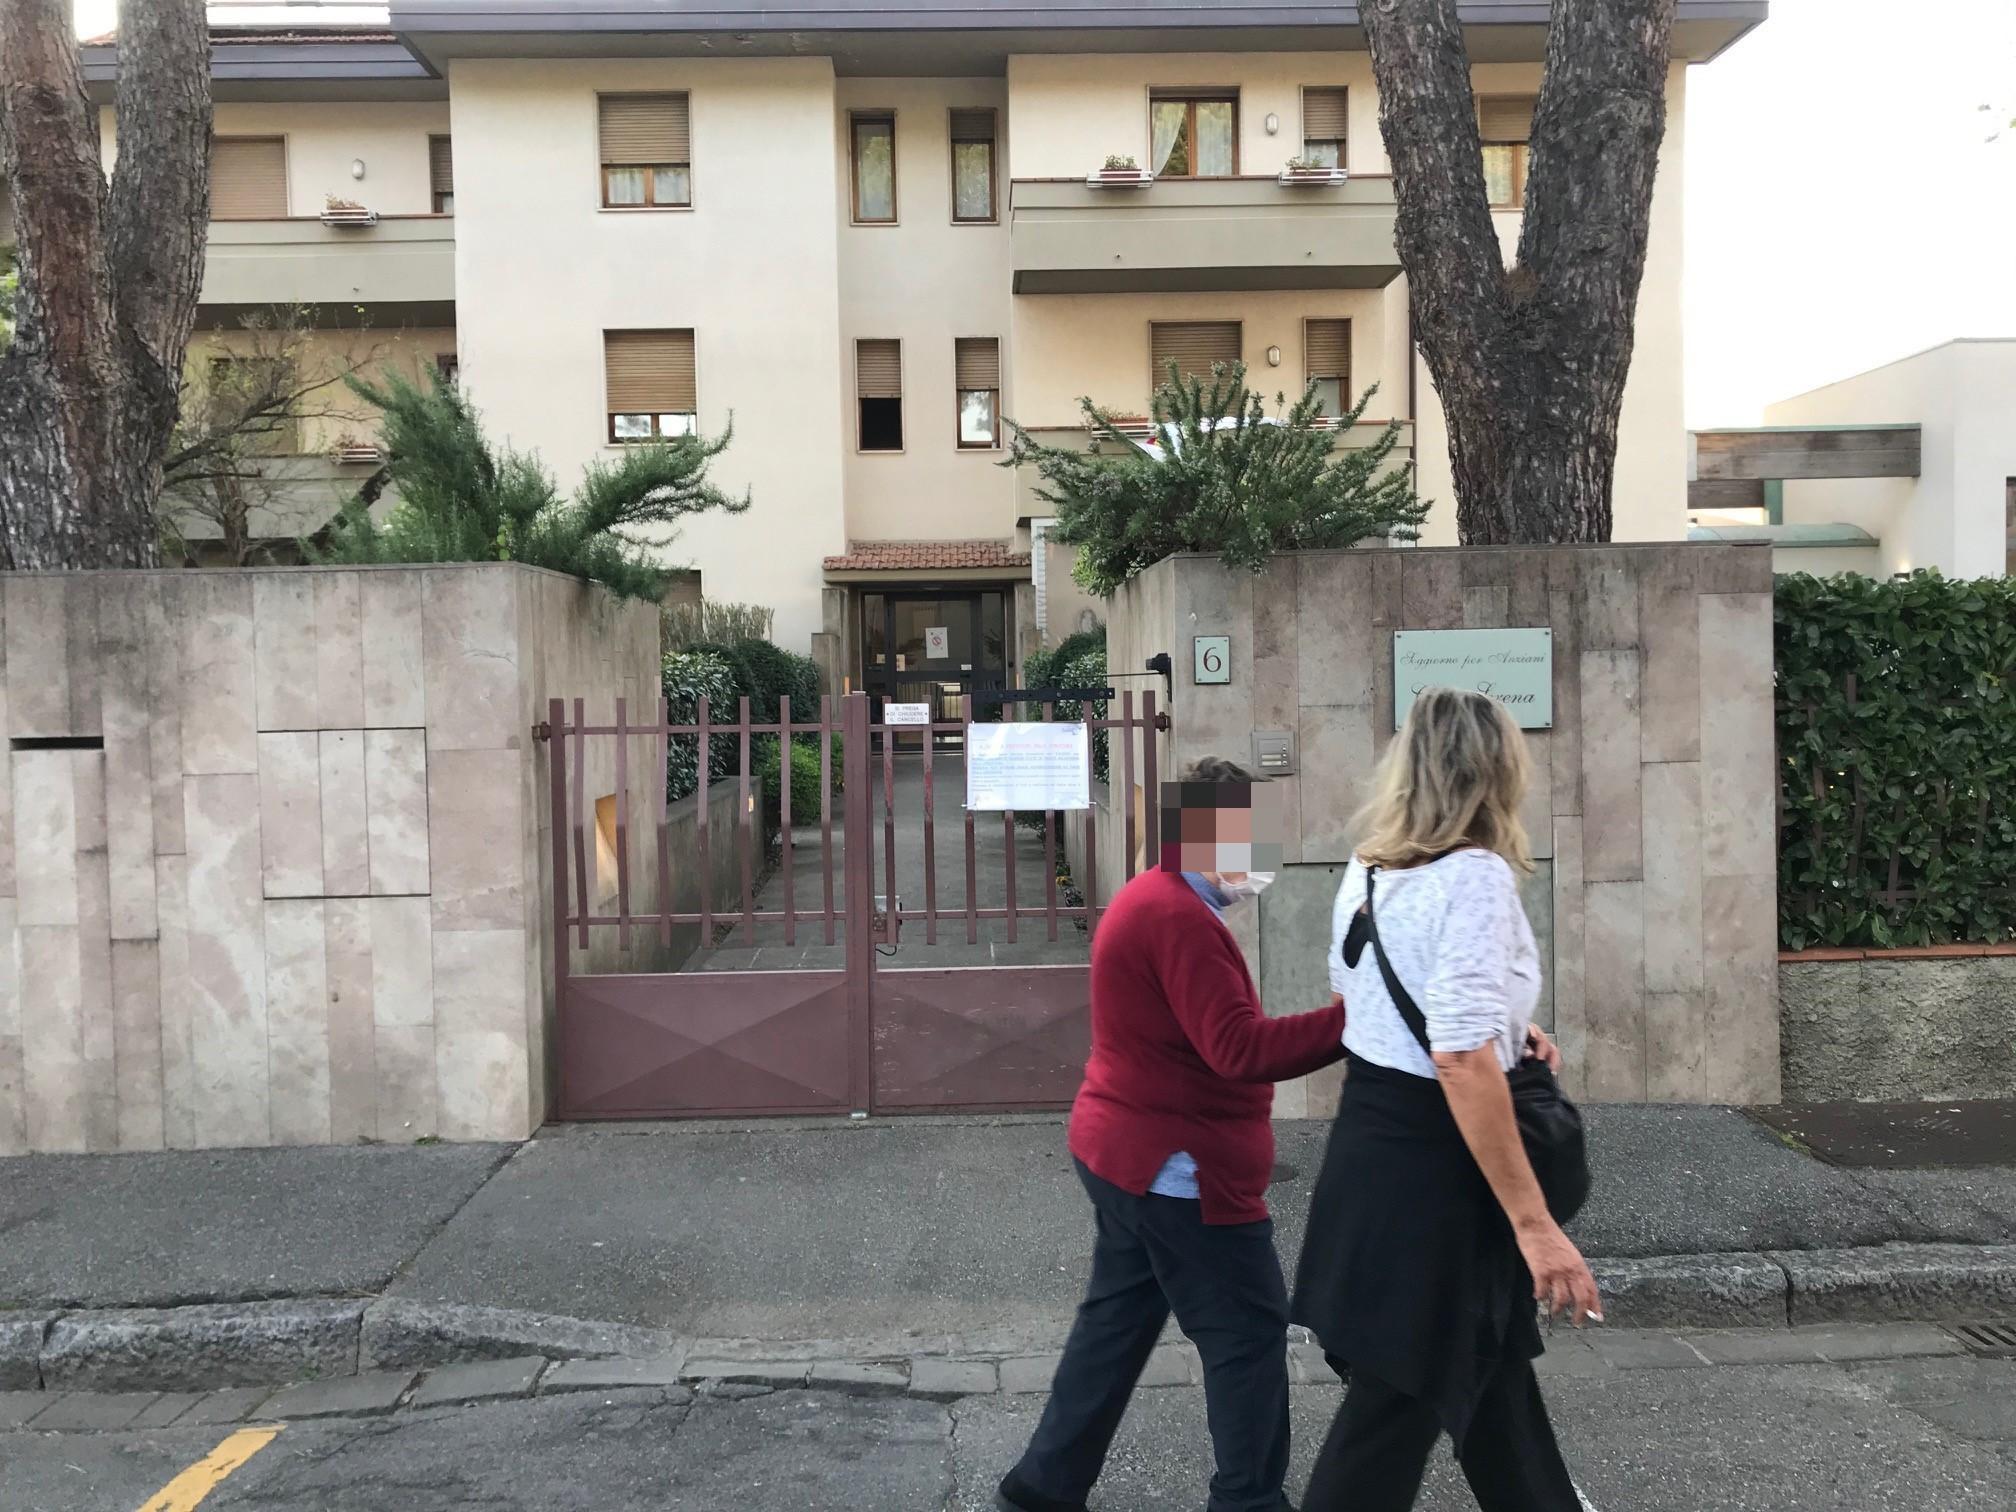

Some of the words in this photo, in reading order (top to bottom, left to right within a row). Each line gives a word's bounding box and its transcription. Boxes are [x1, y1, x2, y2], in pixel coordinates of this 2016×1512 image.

[1203, 646, 1222, 673] 6
[1461, 654, 1484, 669] per
[1488, 649, 1546, 665] Anziani
